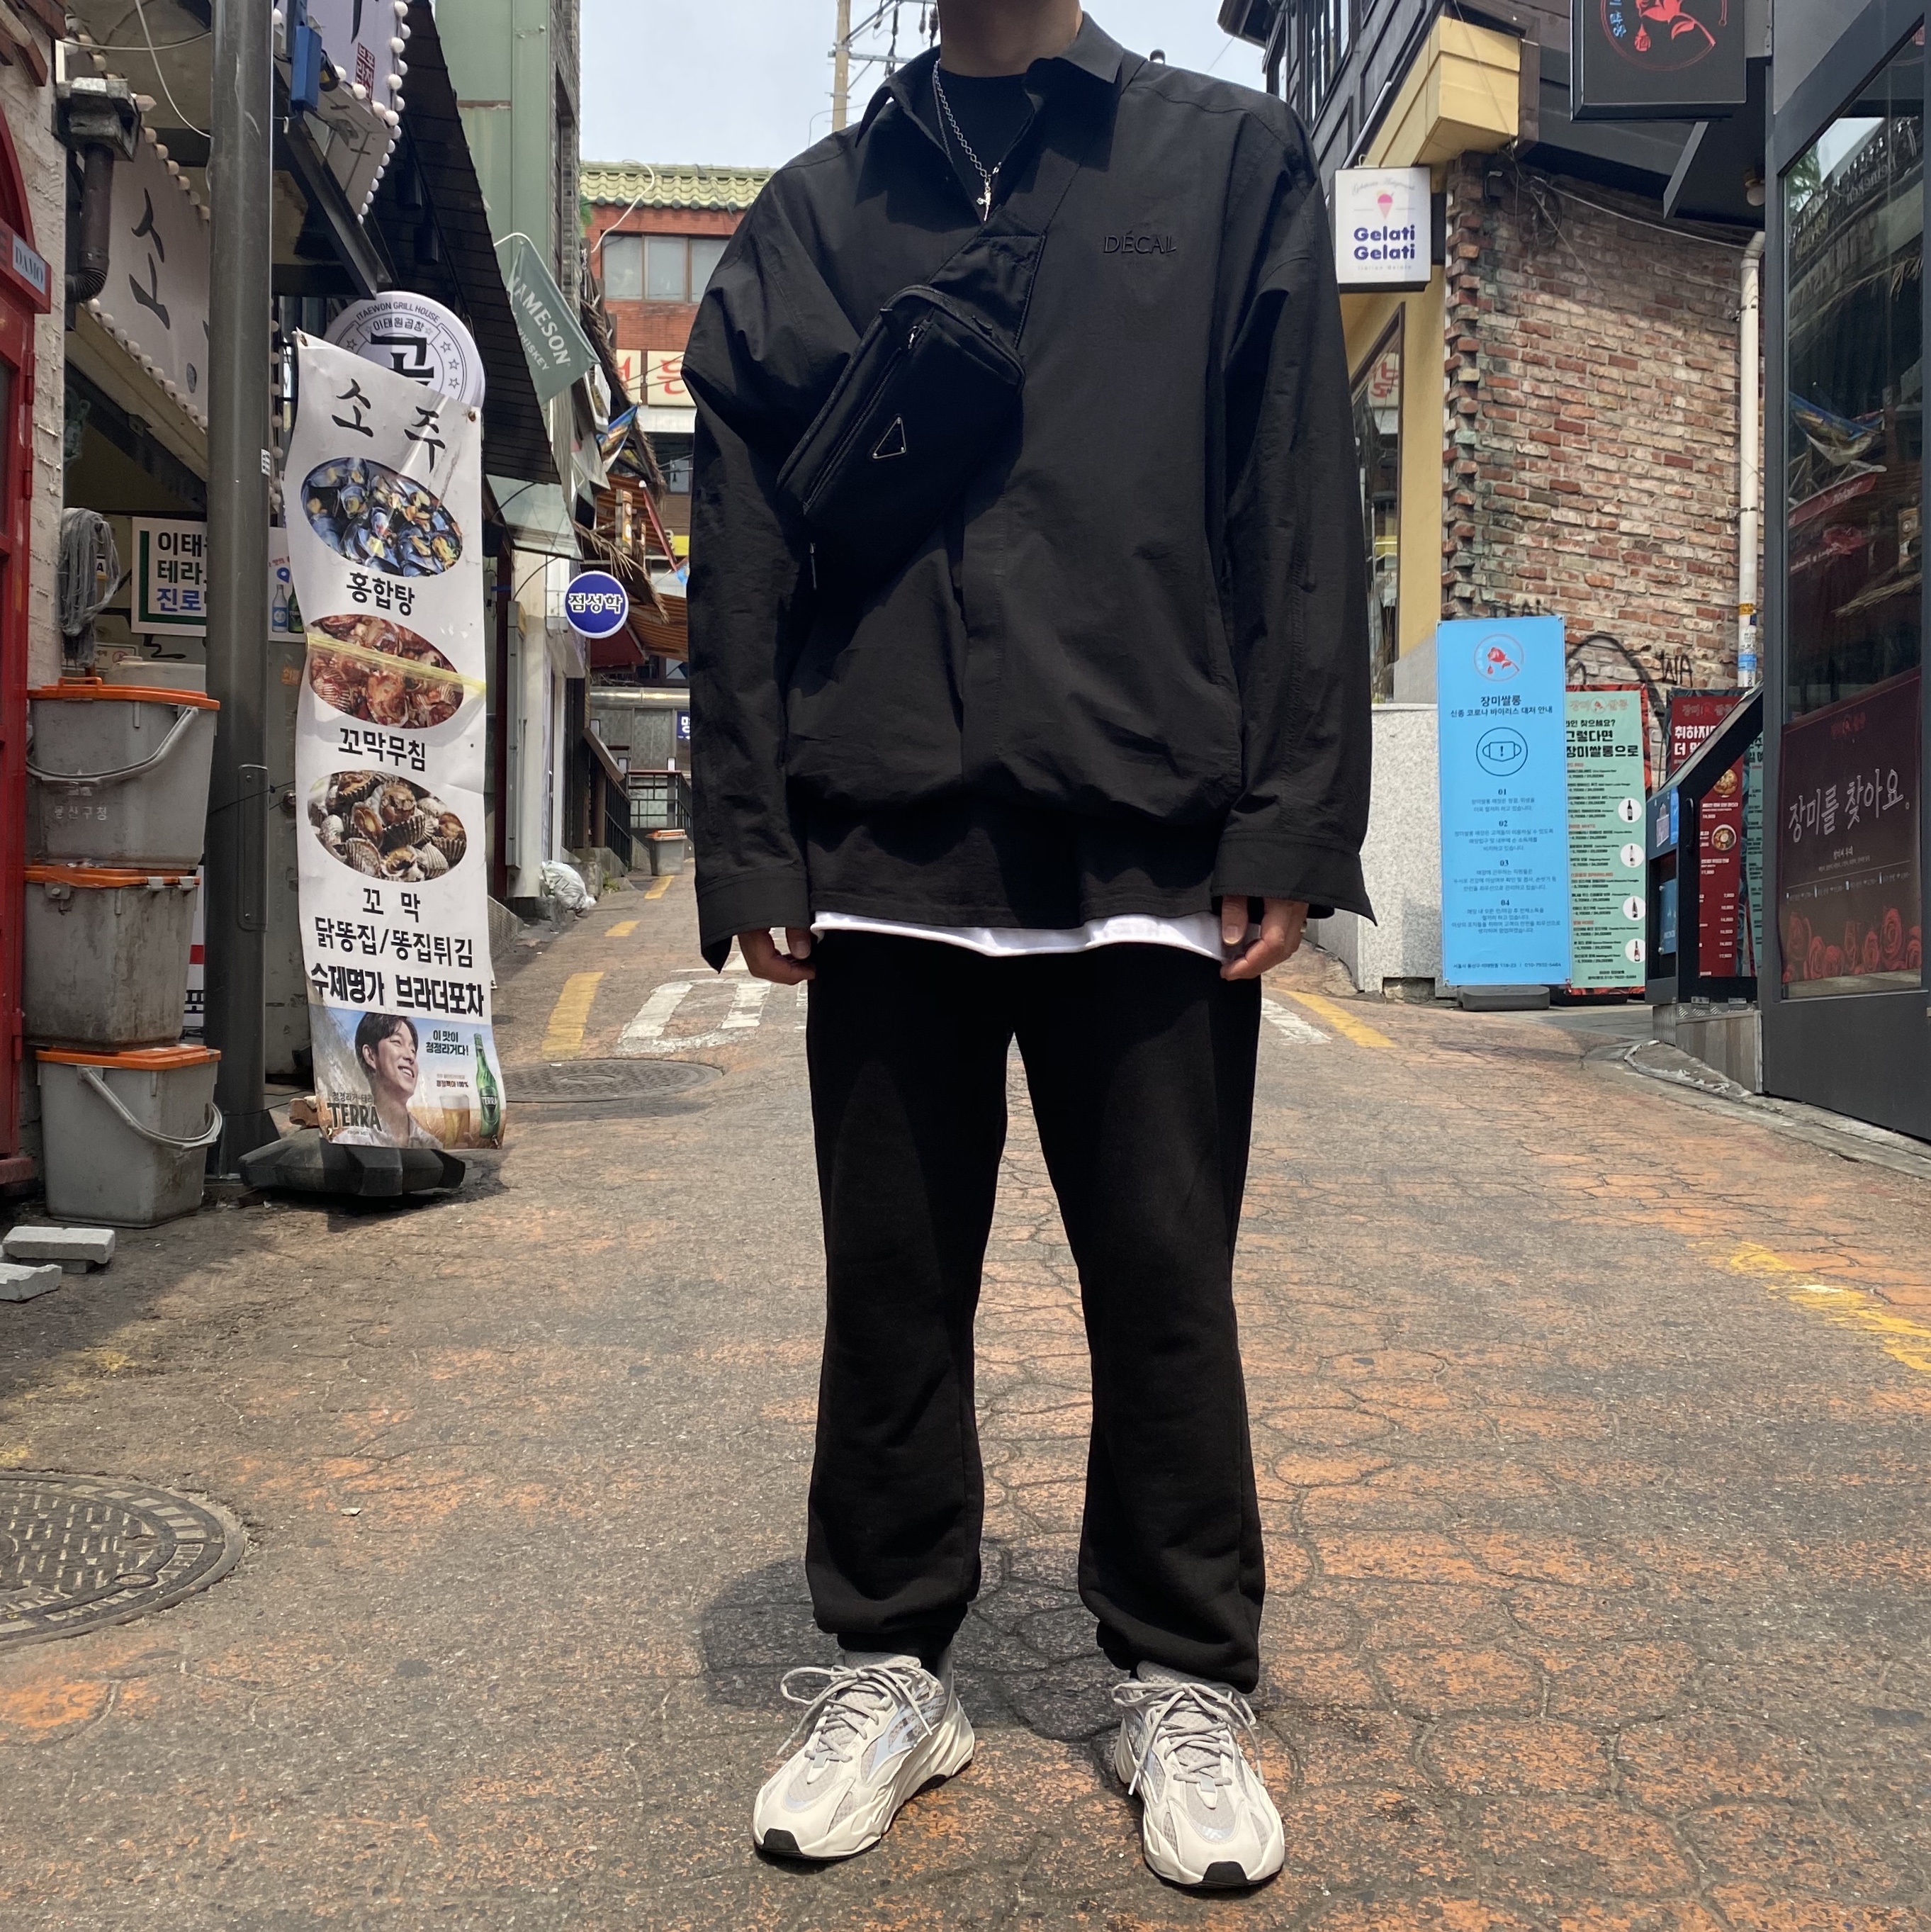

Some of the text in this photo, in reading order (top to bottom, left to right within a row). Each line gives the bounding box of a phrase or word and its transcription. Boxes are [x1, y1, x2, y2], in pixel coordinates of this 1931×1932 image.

[1103, 230, 1177, 254] DÉCAL
[1353, 224, 1416, 242] Gelati
[1353, 243, 1416, 261] Gelati
[15, 245, 44, 285] DAMO
[356, 301, 441, 324] ITAEWON GRILL HOUSE
[373, 317, 425, 332] 이태원곱창
[331, 378, 446, 471] 소 주
[158, 532, 207, 558] 이태
[157, 561, 207, 585] 테라
[156, 588, 207, 612] 진로
[346, 571, 415, 617] 홍합탕
[568, 592, 624, 614] 점성학
[1451, 706, 1553, 718] 신종 코로나 바이러스 대처 안내
[1480, 695, 1522, 707] 장미쌀롱
[1580, 719, 1616, 728] 찾으세요?
[1566, 730, 1614, 743] 그렇다면
[338, 727, 425, 773] 꼬막무침
[1566, 745, 1639, 758] 장미쌀롱으로
[1788, 768, 1910, 843] 장미를 찾아요.
[362, 888, 420, 923] 꼬 막
[315, 916, 473, 969] 닭똥집/똥집튀김
[310, 962, 485, 1017] 수제명가 브라더포차
[426, 1042, 469, 1055] 청정라거다!
[433, 1030, 458, 1043] 이 맛이
[326, 1102, 383, 1133] TERRA
